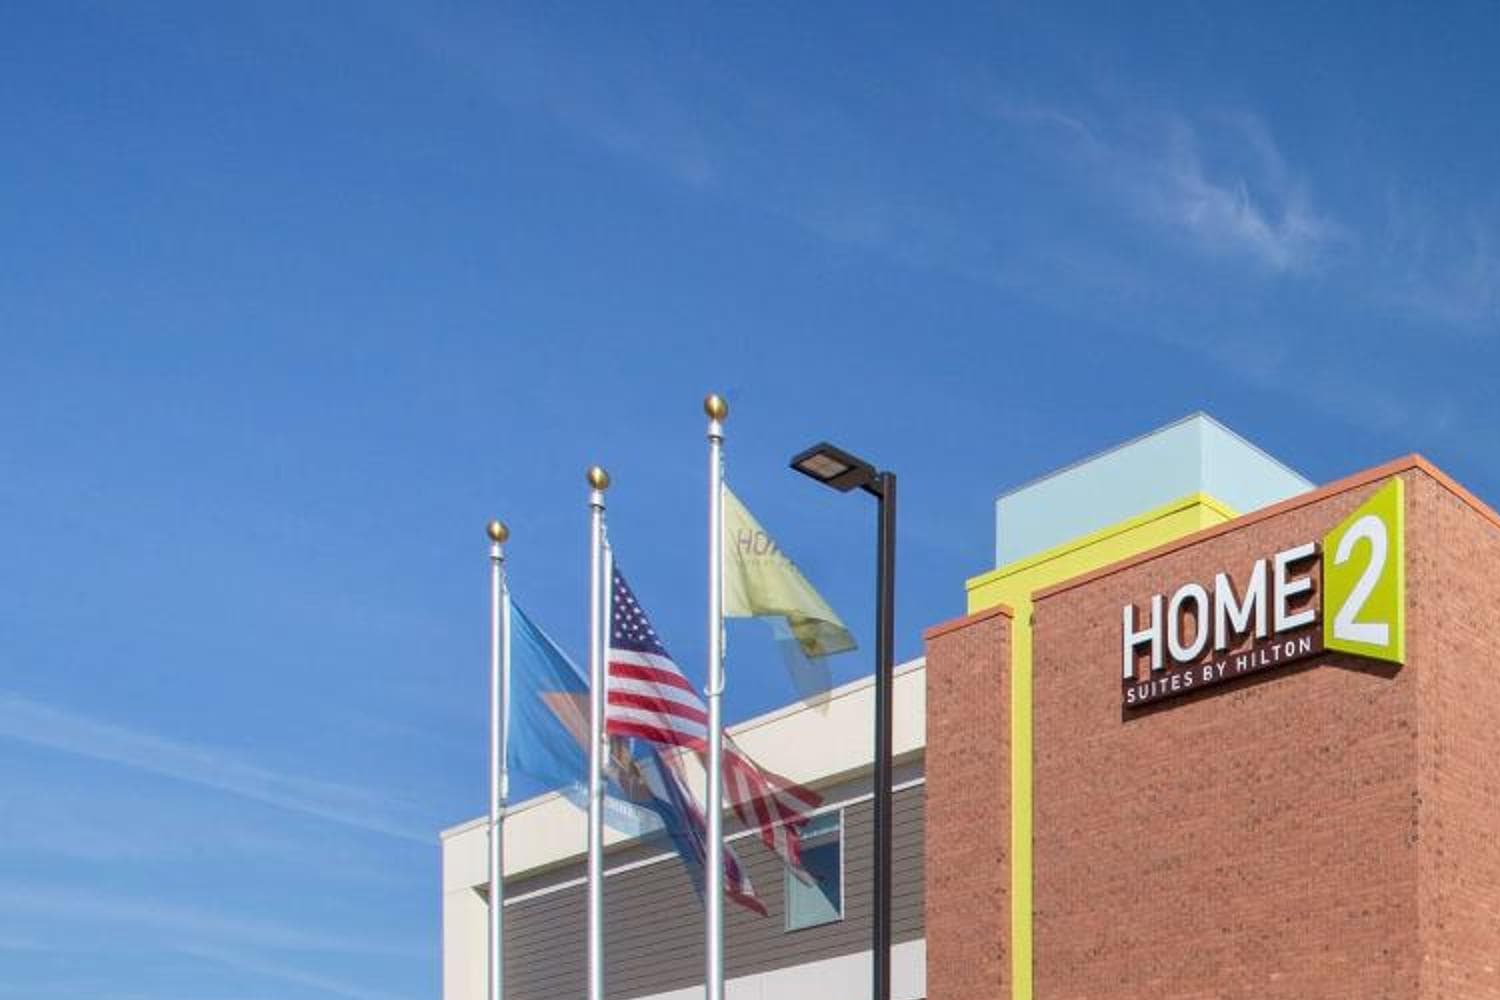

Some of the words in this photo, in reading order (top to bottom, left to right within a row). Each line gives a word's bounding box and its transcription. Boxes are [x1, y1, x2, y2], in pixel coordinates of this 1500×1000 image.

[1123, 541, 1317, 679] HOME
[1333, 514, 1390, 646] 2
[1127, 671, 1193, 703] SUITES
[1203, 661, 1227, 682] BY
[1236, 636, 1312, 672] HILTON
